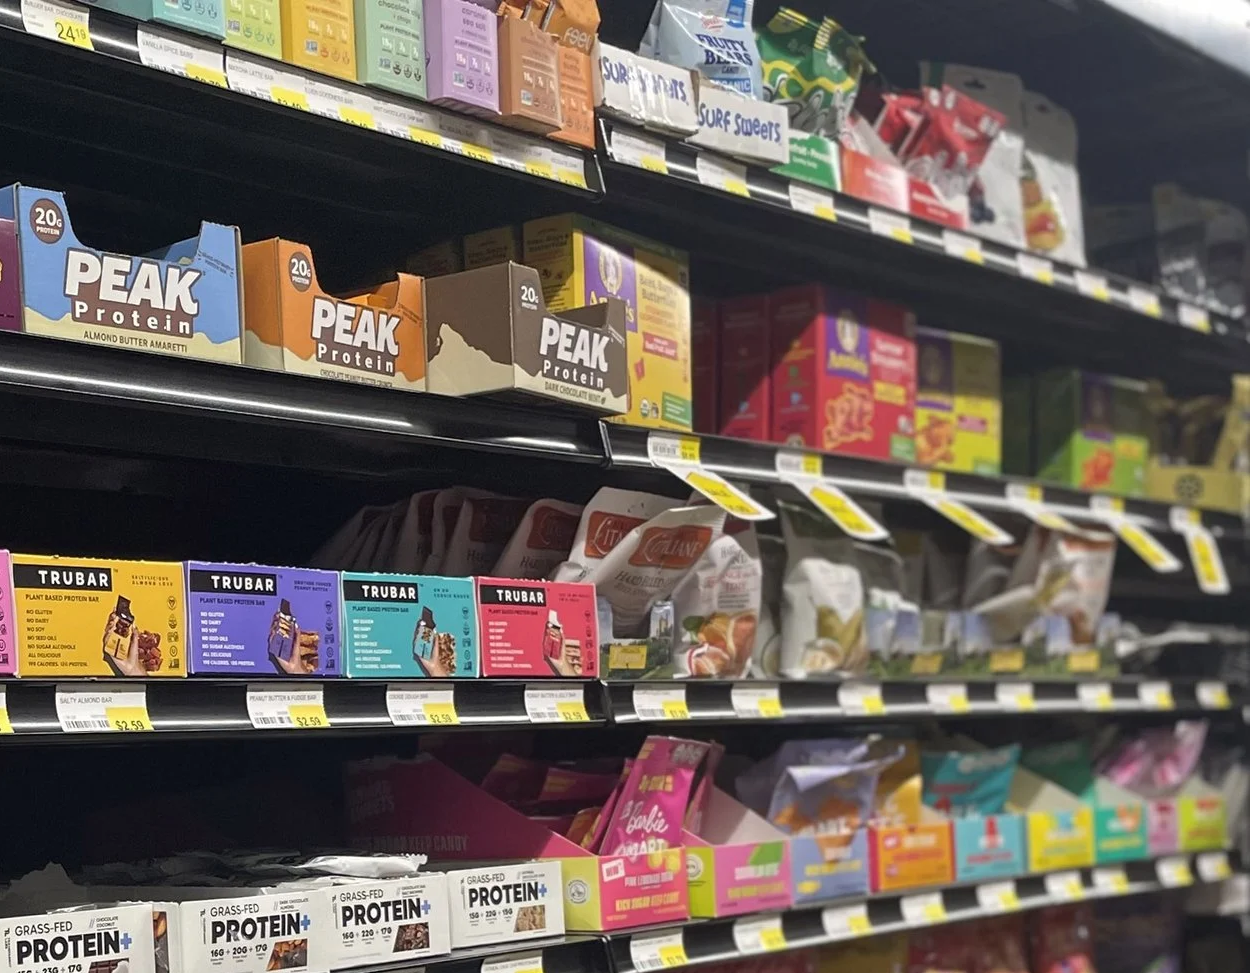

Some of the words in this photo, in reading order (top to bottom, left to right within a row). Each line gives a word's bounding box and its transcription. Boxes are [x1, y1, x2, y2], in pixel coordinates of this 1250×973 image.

[66, 250, 200, 315] PEAK
[74, 300, 191, 335] Protein
[312, 299, 400, 356] PEAK
[83, 329, 118, 344] ALMOND
[118, 334, 148, 348] BUTTER
[149, 338, 187, 353] AMARETTI
[539, 317, 609, 372] PEAK
[318, 343, 394, 373] Protein
[543, 360, 604, 389] Protein
[38, 569, 109, 587] TRUBAR
[211, 575, 275, 592] TRUBAR
[361, 585, 416, 600] TRUBAR
[496, 589, 544, 604] TRUBAR
[466, 874, 505, 886] GRASS-FED
